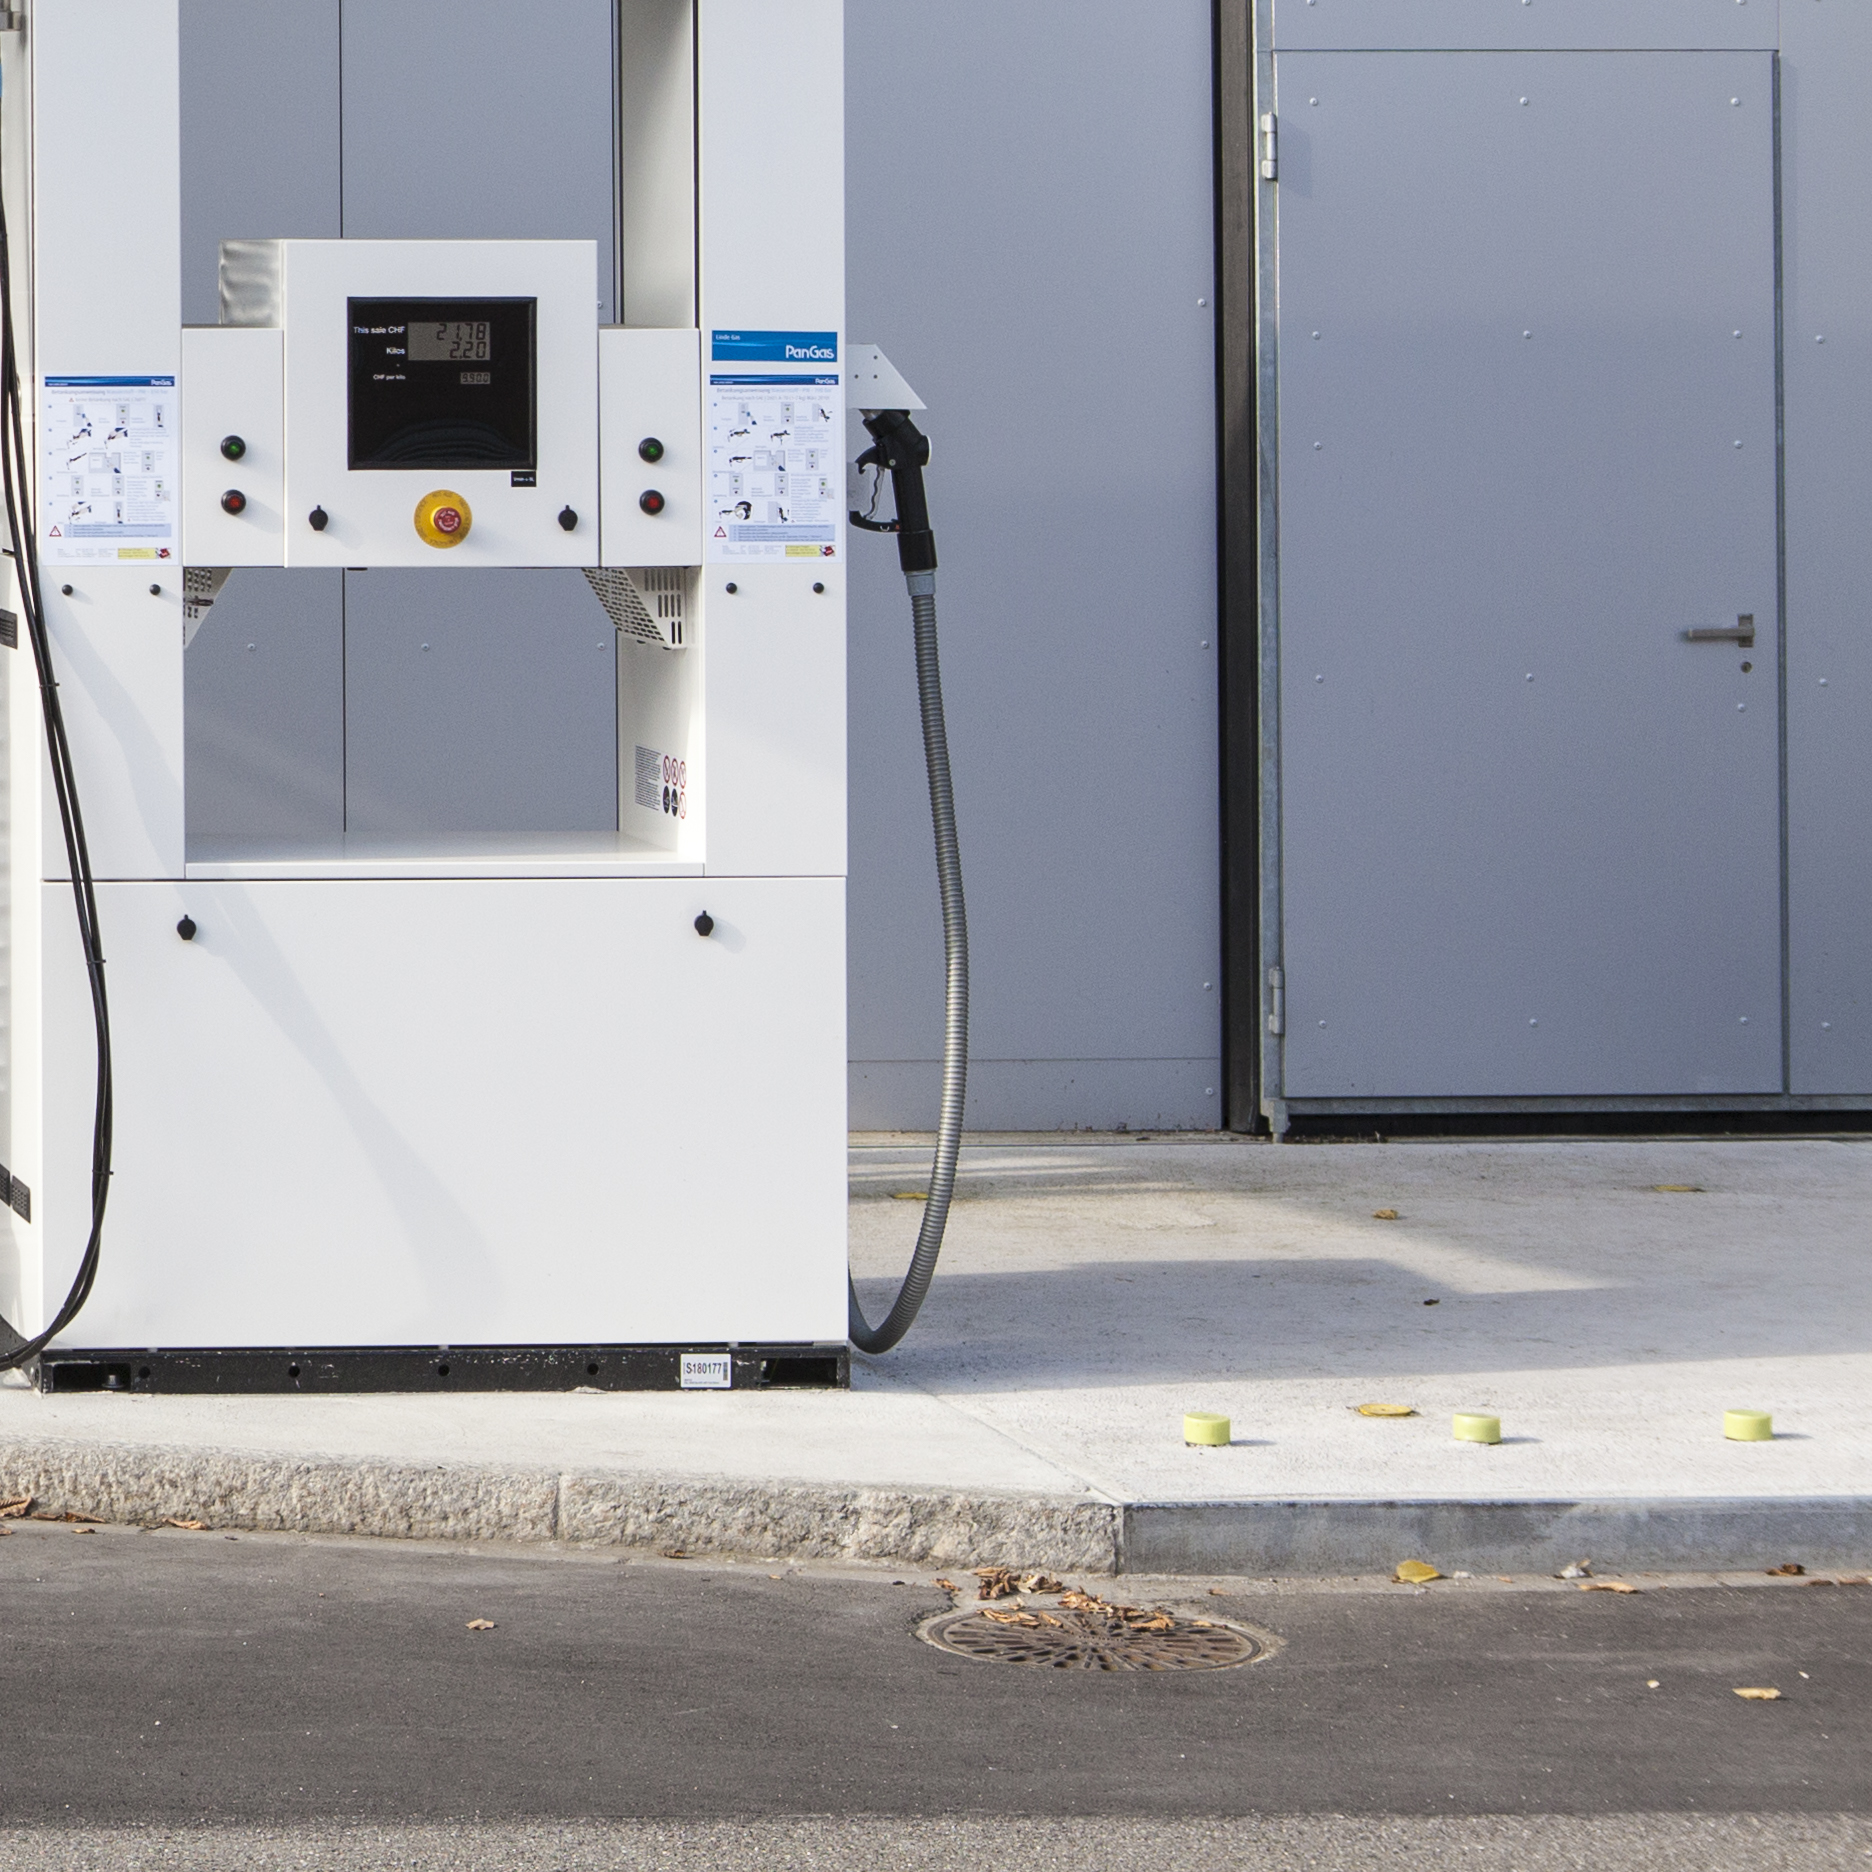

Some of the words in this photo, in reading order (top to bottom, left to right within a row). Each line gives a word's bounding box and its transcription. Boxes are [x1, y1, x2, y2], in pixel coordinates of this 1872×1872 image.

[354, 326, 369, 334] This
[370, 326, 386, 334] sale
[388, 326, 405, 334] CHF
[436, 323, 487, 341] 21.78
[386, 347, 405, 355] Kilos
[450, 341, 487, 359] 2.20
[785, 344, 834, 359] PanGas
[686, 1362, 722, 1374] S180177
